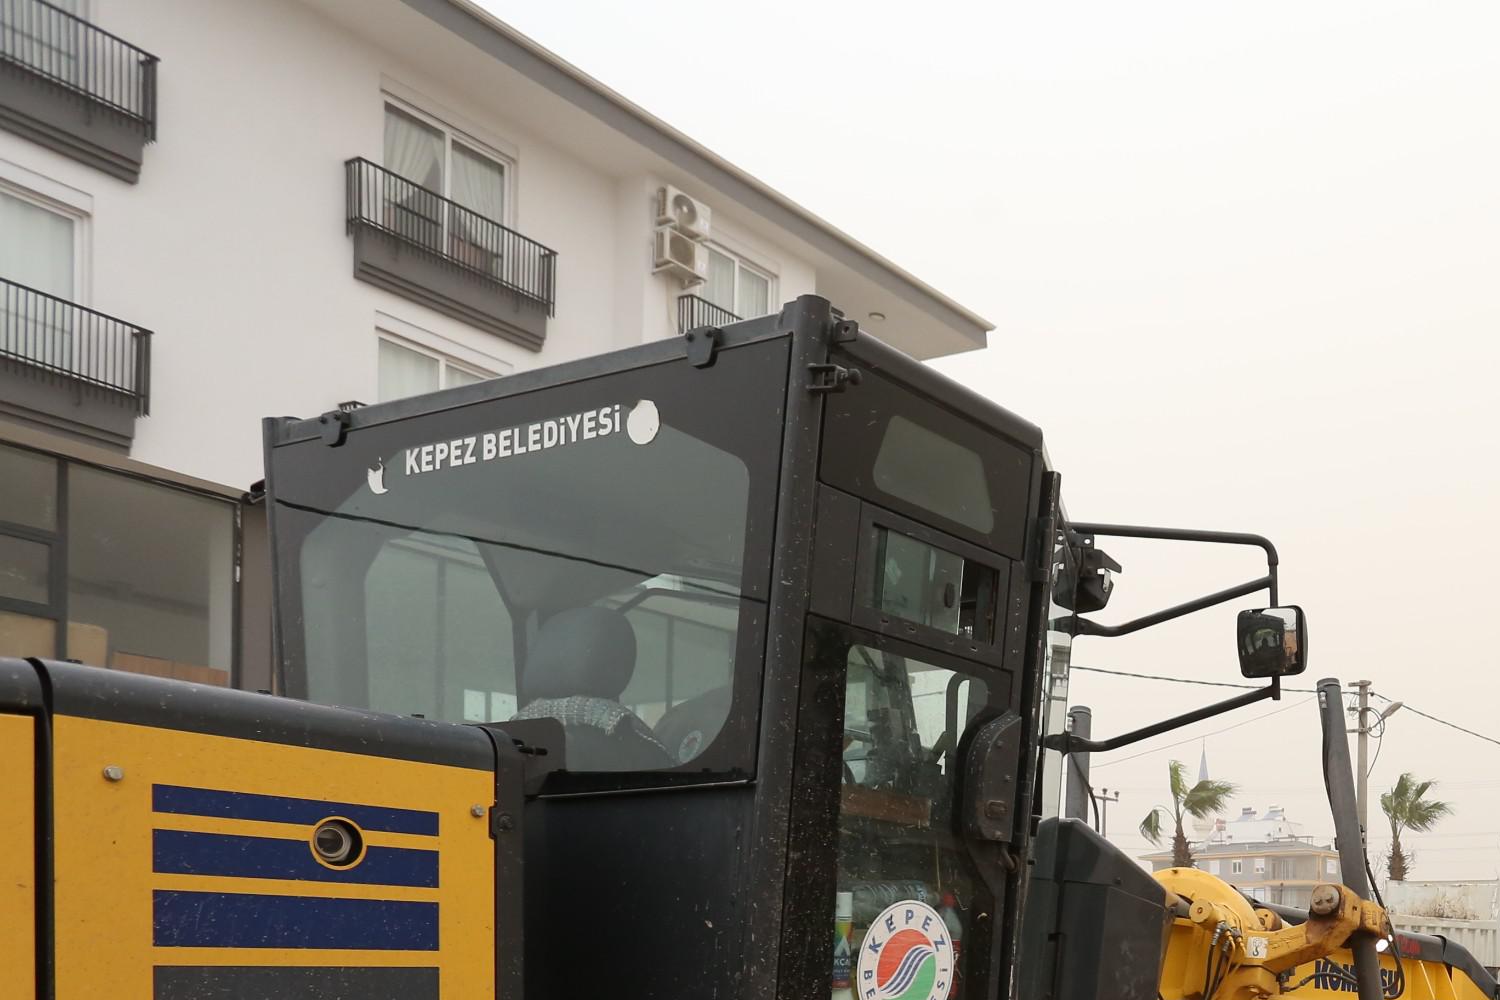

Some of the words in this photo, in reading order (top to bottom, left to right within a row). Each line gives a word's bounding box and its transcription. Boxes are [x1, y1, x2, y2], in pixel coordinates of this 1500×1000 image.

[405, 436, 477, 476] KEPEZ
[868, 909, 947, 955] KEPEZ
[1314, 959, 1399, 996] KOMSU
